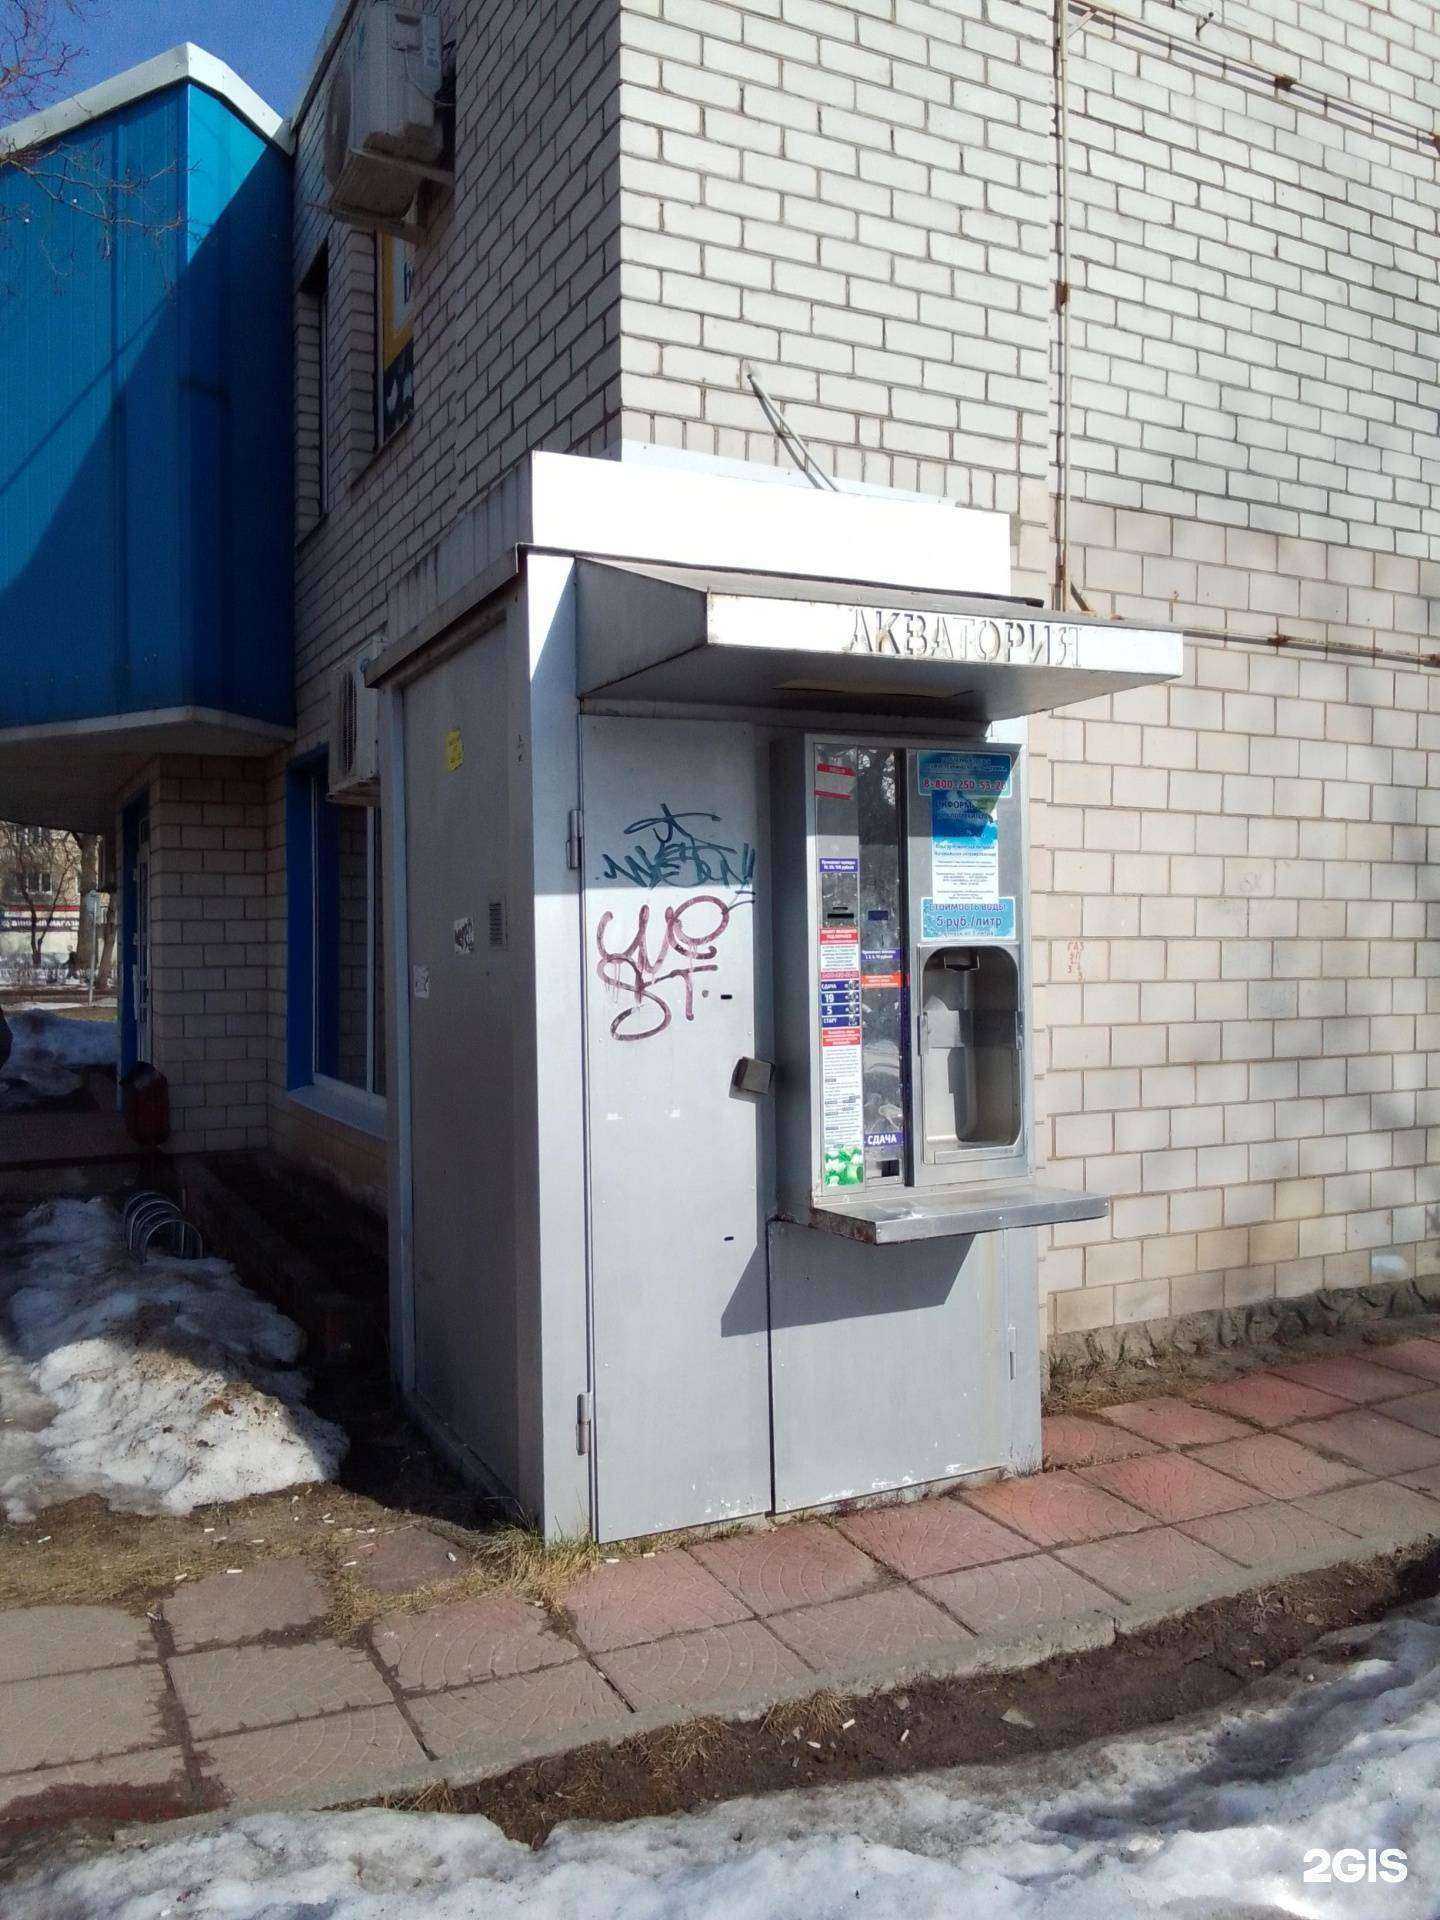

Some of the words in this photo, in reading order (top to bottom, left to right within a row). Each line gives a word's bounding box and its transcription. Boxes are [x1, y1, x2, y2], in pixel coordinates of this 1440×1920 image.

[848, 608, 1081, 667] АКВАТОРИЯ
[826, 1005, 833, 1015] 5
[867, 1133, 897, 1146] СДАЧА
